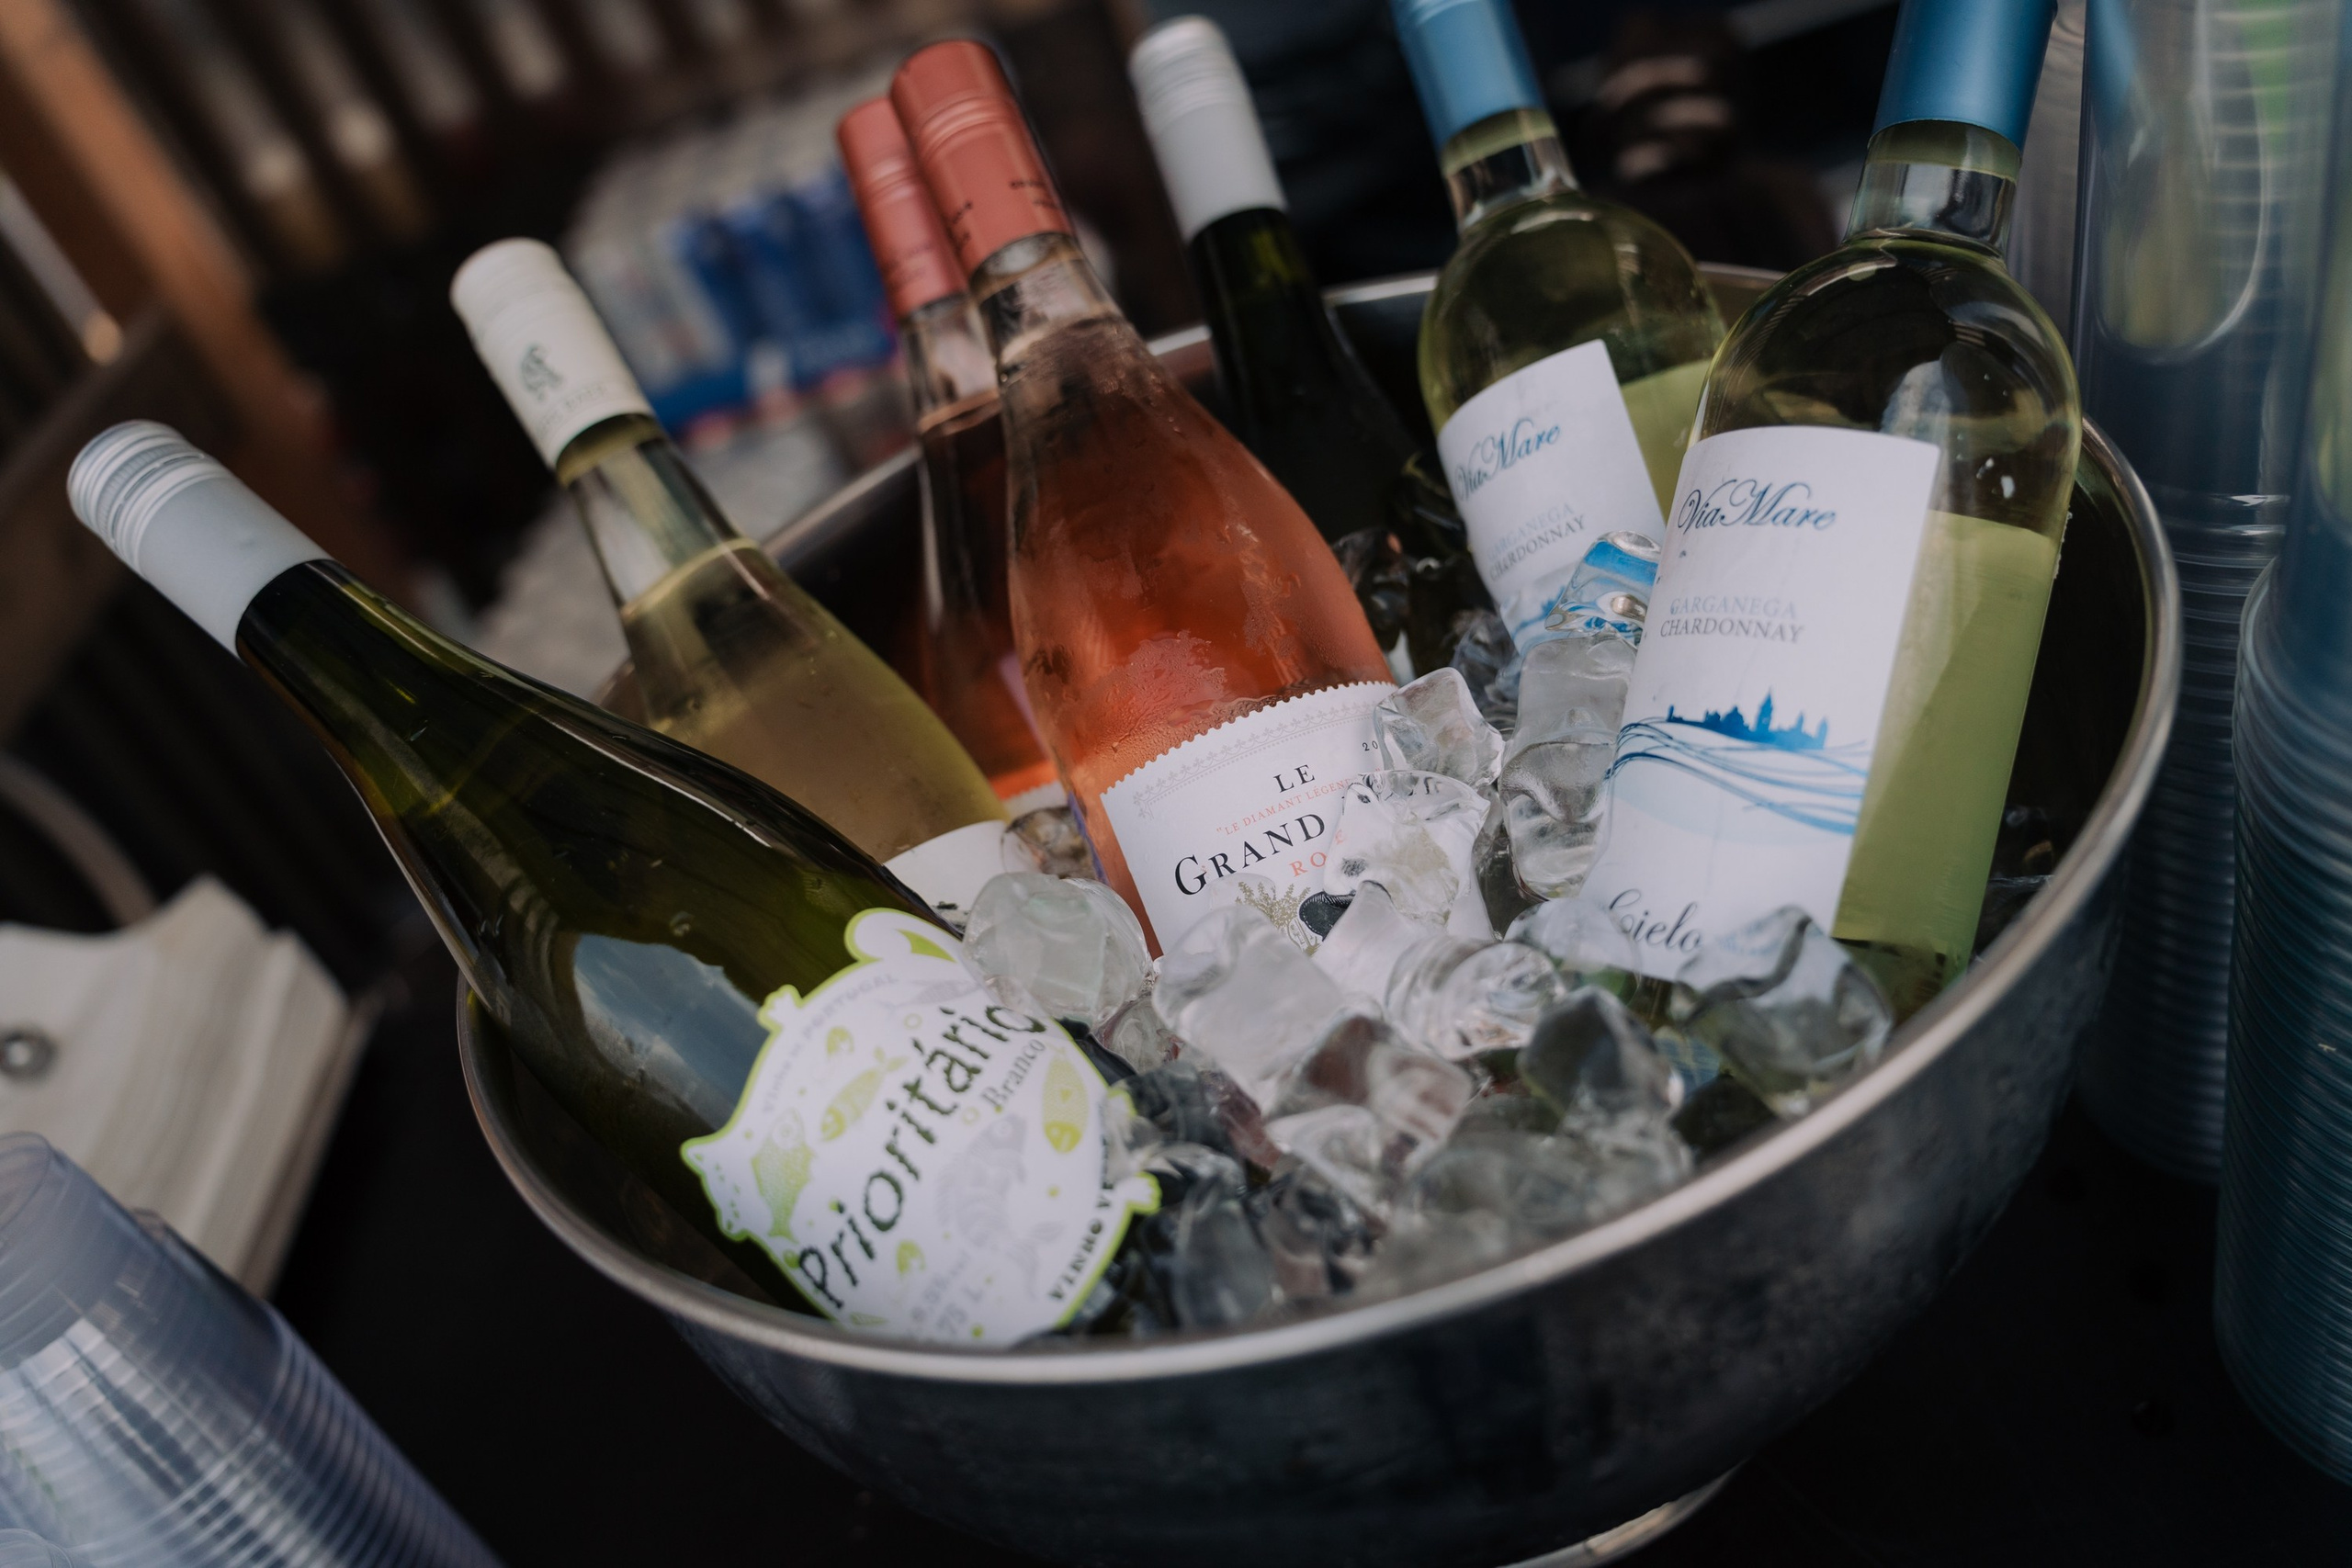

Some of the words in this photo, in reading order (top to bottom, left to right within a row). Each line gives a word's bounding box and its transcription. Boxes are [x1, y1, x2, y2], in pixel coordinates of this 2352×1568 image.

[1489, 514, 1585, 582] CHARDONNAY
[1669, 596, 1798, 619] GARGANEGA
[1660, 617, 1805, 643] CHARDONNAY
[1273, 764, 1315, 794] LE
[1243, 796, 1302, 827] DIAMANT
[980, 1038, 1046, 1108] Branco
